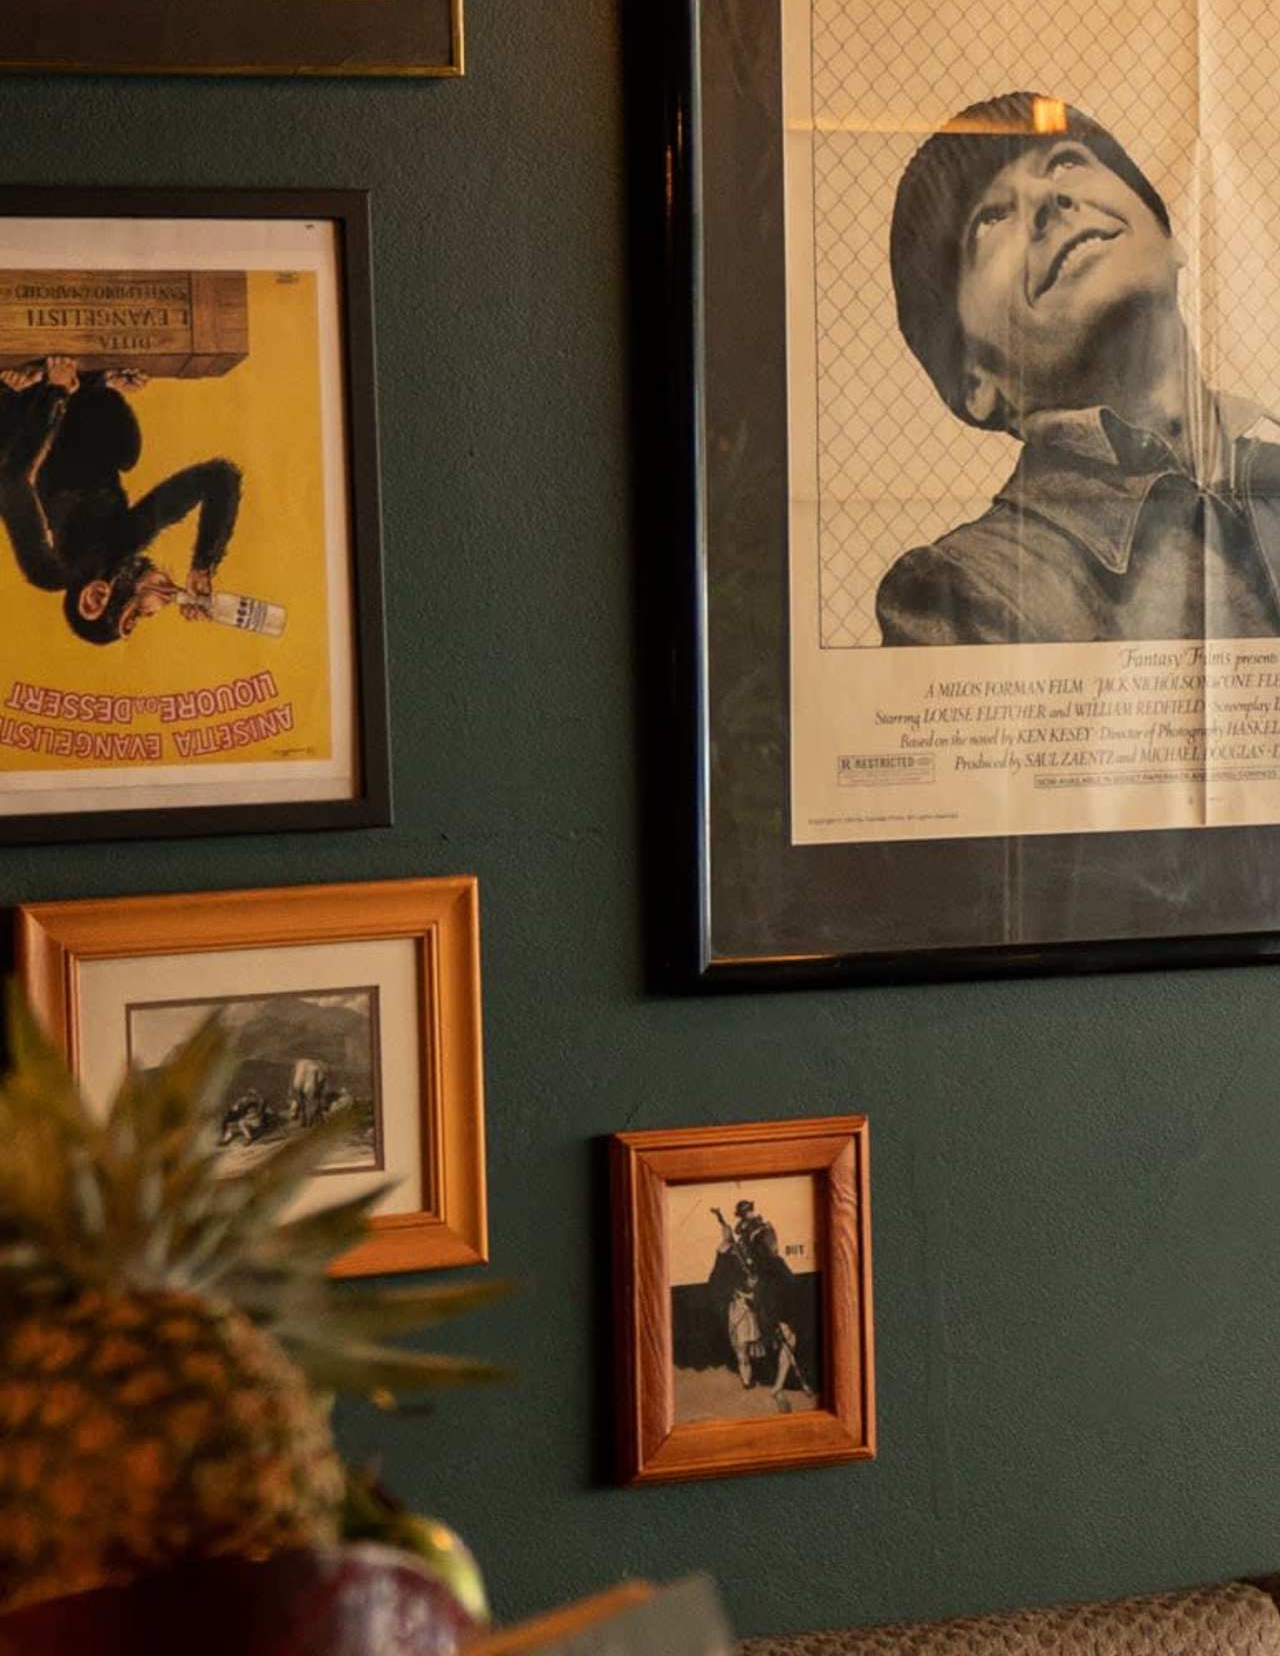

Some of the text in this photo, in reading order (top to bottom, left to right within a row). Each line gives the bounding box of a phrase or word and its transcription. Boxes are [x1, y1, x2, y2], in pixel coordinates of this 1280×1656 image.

[27, 308, 169, 328] EVANGELISTI
[159, 670, 279, 723] LIQUORE
[983, 679, 1046, 696] FORMAN
[1049, 678, 1084, 694] FILM
[5, 681, 135, 724] DESSERT
[975, 705, 1047, 723] FLETCHER
[174, 702, 295, 758] ANISETTA
[1016, 728, 1047, 744] KEN
[1048, 726, 1093, 743] KESEY
